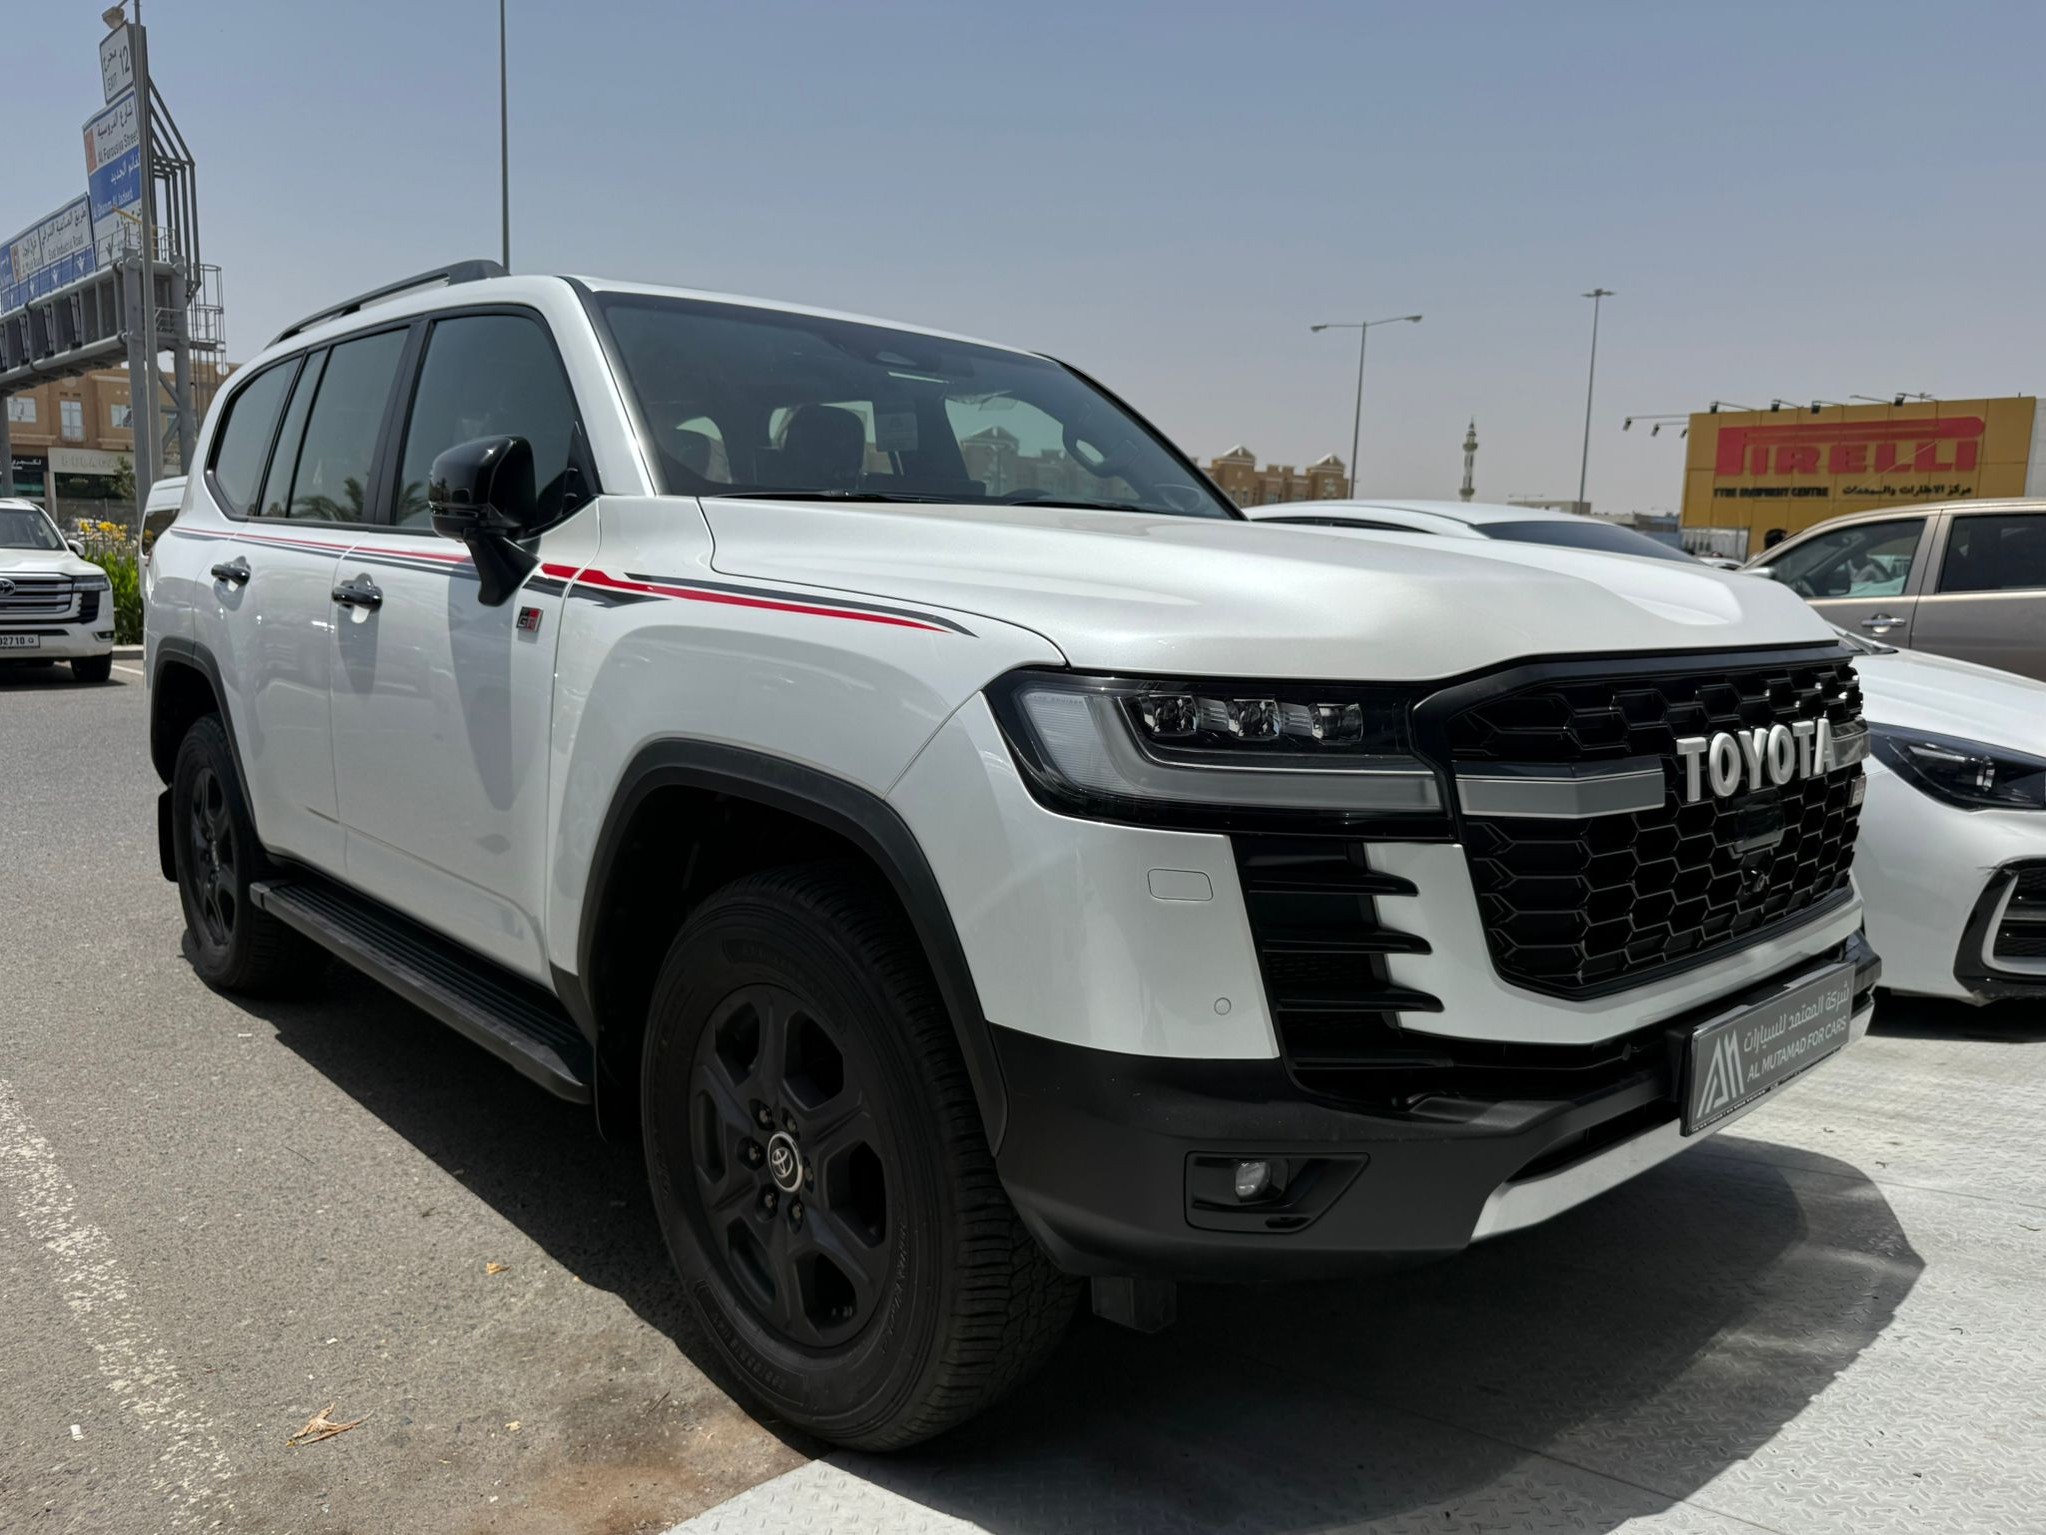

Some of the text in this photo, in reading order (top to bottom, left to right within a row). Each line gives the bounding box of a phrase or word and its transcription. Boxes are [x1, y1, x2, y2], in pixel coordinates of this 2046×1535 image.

[107, 71, 117, 92] EXIT
[119, 45, 131, 76] 12
[1716, 416, 1985, 476] PIRELLI
[1676, 718, 1836, 802] TOYOTA
[1743, 980, 1850, 1054] شركة المعتمد للسيارات
[1747, 1015, 1847, 1082] AL MUTAMAD FOR CARS
